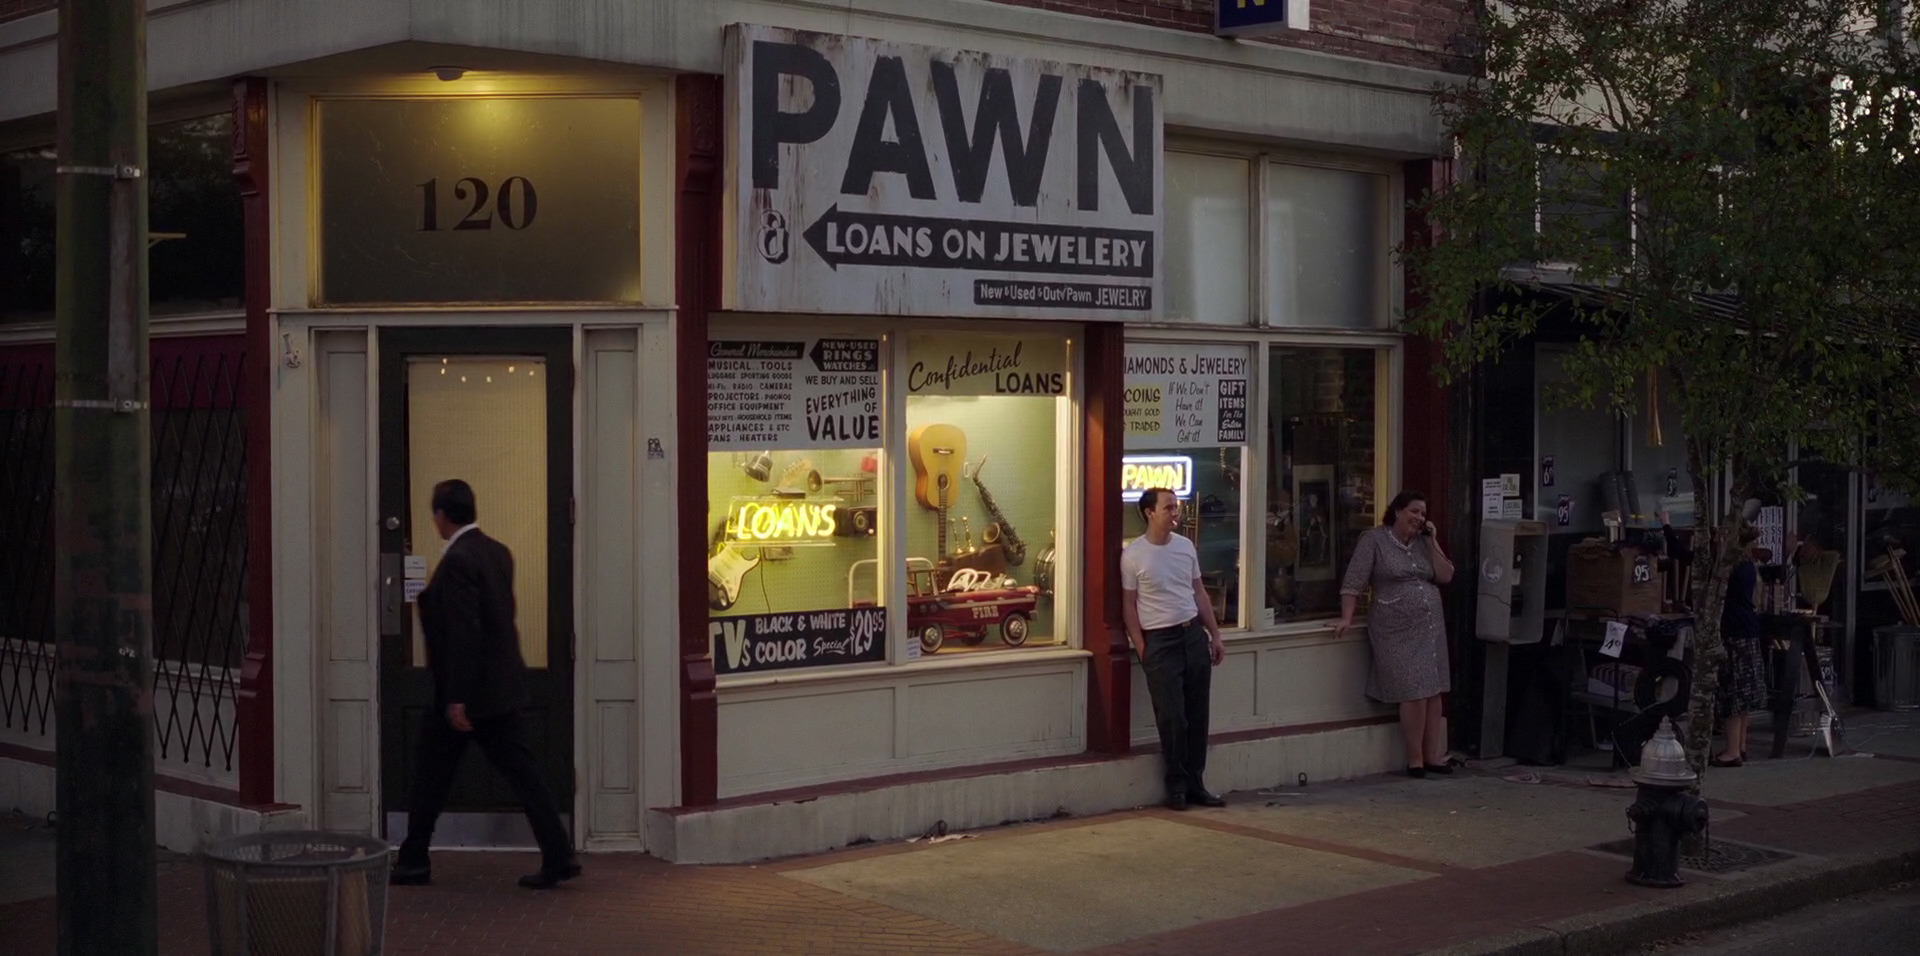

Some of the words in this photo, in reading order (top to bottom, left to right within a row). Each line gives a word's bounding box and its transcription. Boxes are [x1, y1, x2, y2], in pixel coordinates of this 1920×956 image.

[753, 40, 1154, 216] PAWN
[415, 175, 538, 232] 120
[826, 221, 933, 259] LOANS
[942, 227, 985, 257] ON
[994, 231, 1147, 266] JEWELERY
[980, 284, 1003, 299] New
[1010, 284, 1036, 300] Used
[1096, 288, 1147, 307] JEWELRY
[823, 350, 873, 361] RINGS
[708, 361, 751, 371] MUSICAL
[760, 361, 792, 371] TOOLS
[823, 361, 867, 371] WATCHES
[908, 341, 1023, 392] Confidential
[1123, 357, 1174, 374] IAMONDS
[1180, 358, 1187, 374] &
[760, 382, 792, 390] CAMERAS
[805, 375, 818, 385] WE
[821, 375, 837, 385] BUY
[839, 375, 857, 385] AND
[859, 375, 879, 385] SELL
[995, 373, 1064, 393] LOANS
[1175, 381, 1187, 396] We
[1220, 381, 1246, 396] GIFT
[708, 392, 759, 401] PROJECTORS
[806, 387, 876, 415] EVERYTHING
[1219, 397, 1246, 410] ITEMS
[708, 402, 736, 410] OFFICE
[740, 402, 785, 410] EQUIPMENT
[864, 402, 878, 413] OF
[1175, 398, 1193, 412] Have
[708, 423, 764, 432] APPLIANCES
[806, 415, 880, 441] VALUE
[1130, 421, 1161, 432] TRADED
[1175, 415, 1188, 427] We
[1189, 414, 1203, 427] Can
[708, 433, 731, 442] FANS
[740, 433, 778, 442] HEATERS
[1218, 430, 1246, 441] FAMILY
[1122, 463, 1185, 491] PAWN
[737, 503, 837, 539] LOANS
[1634, 564, 1650, 584] 95
[755, 616, 793, 635] BLACK
[797, 615, 806, 631] &
[810, 612, 846, 630] WHITE
[755, 638, 807, 664] COLOR
[813, 636, 850, 656] Special
